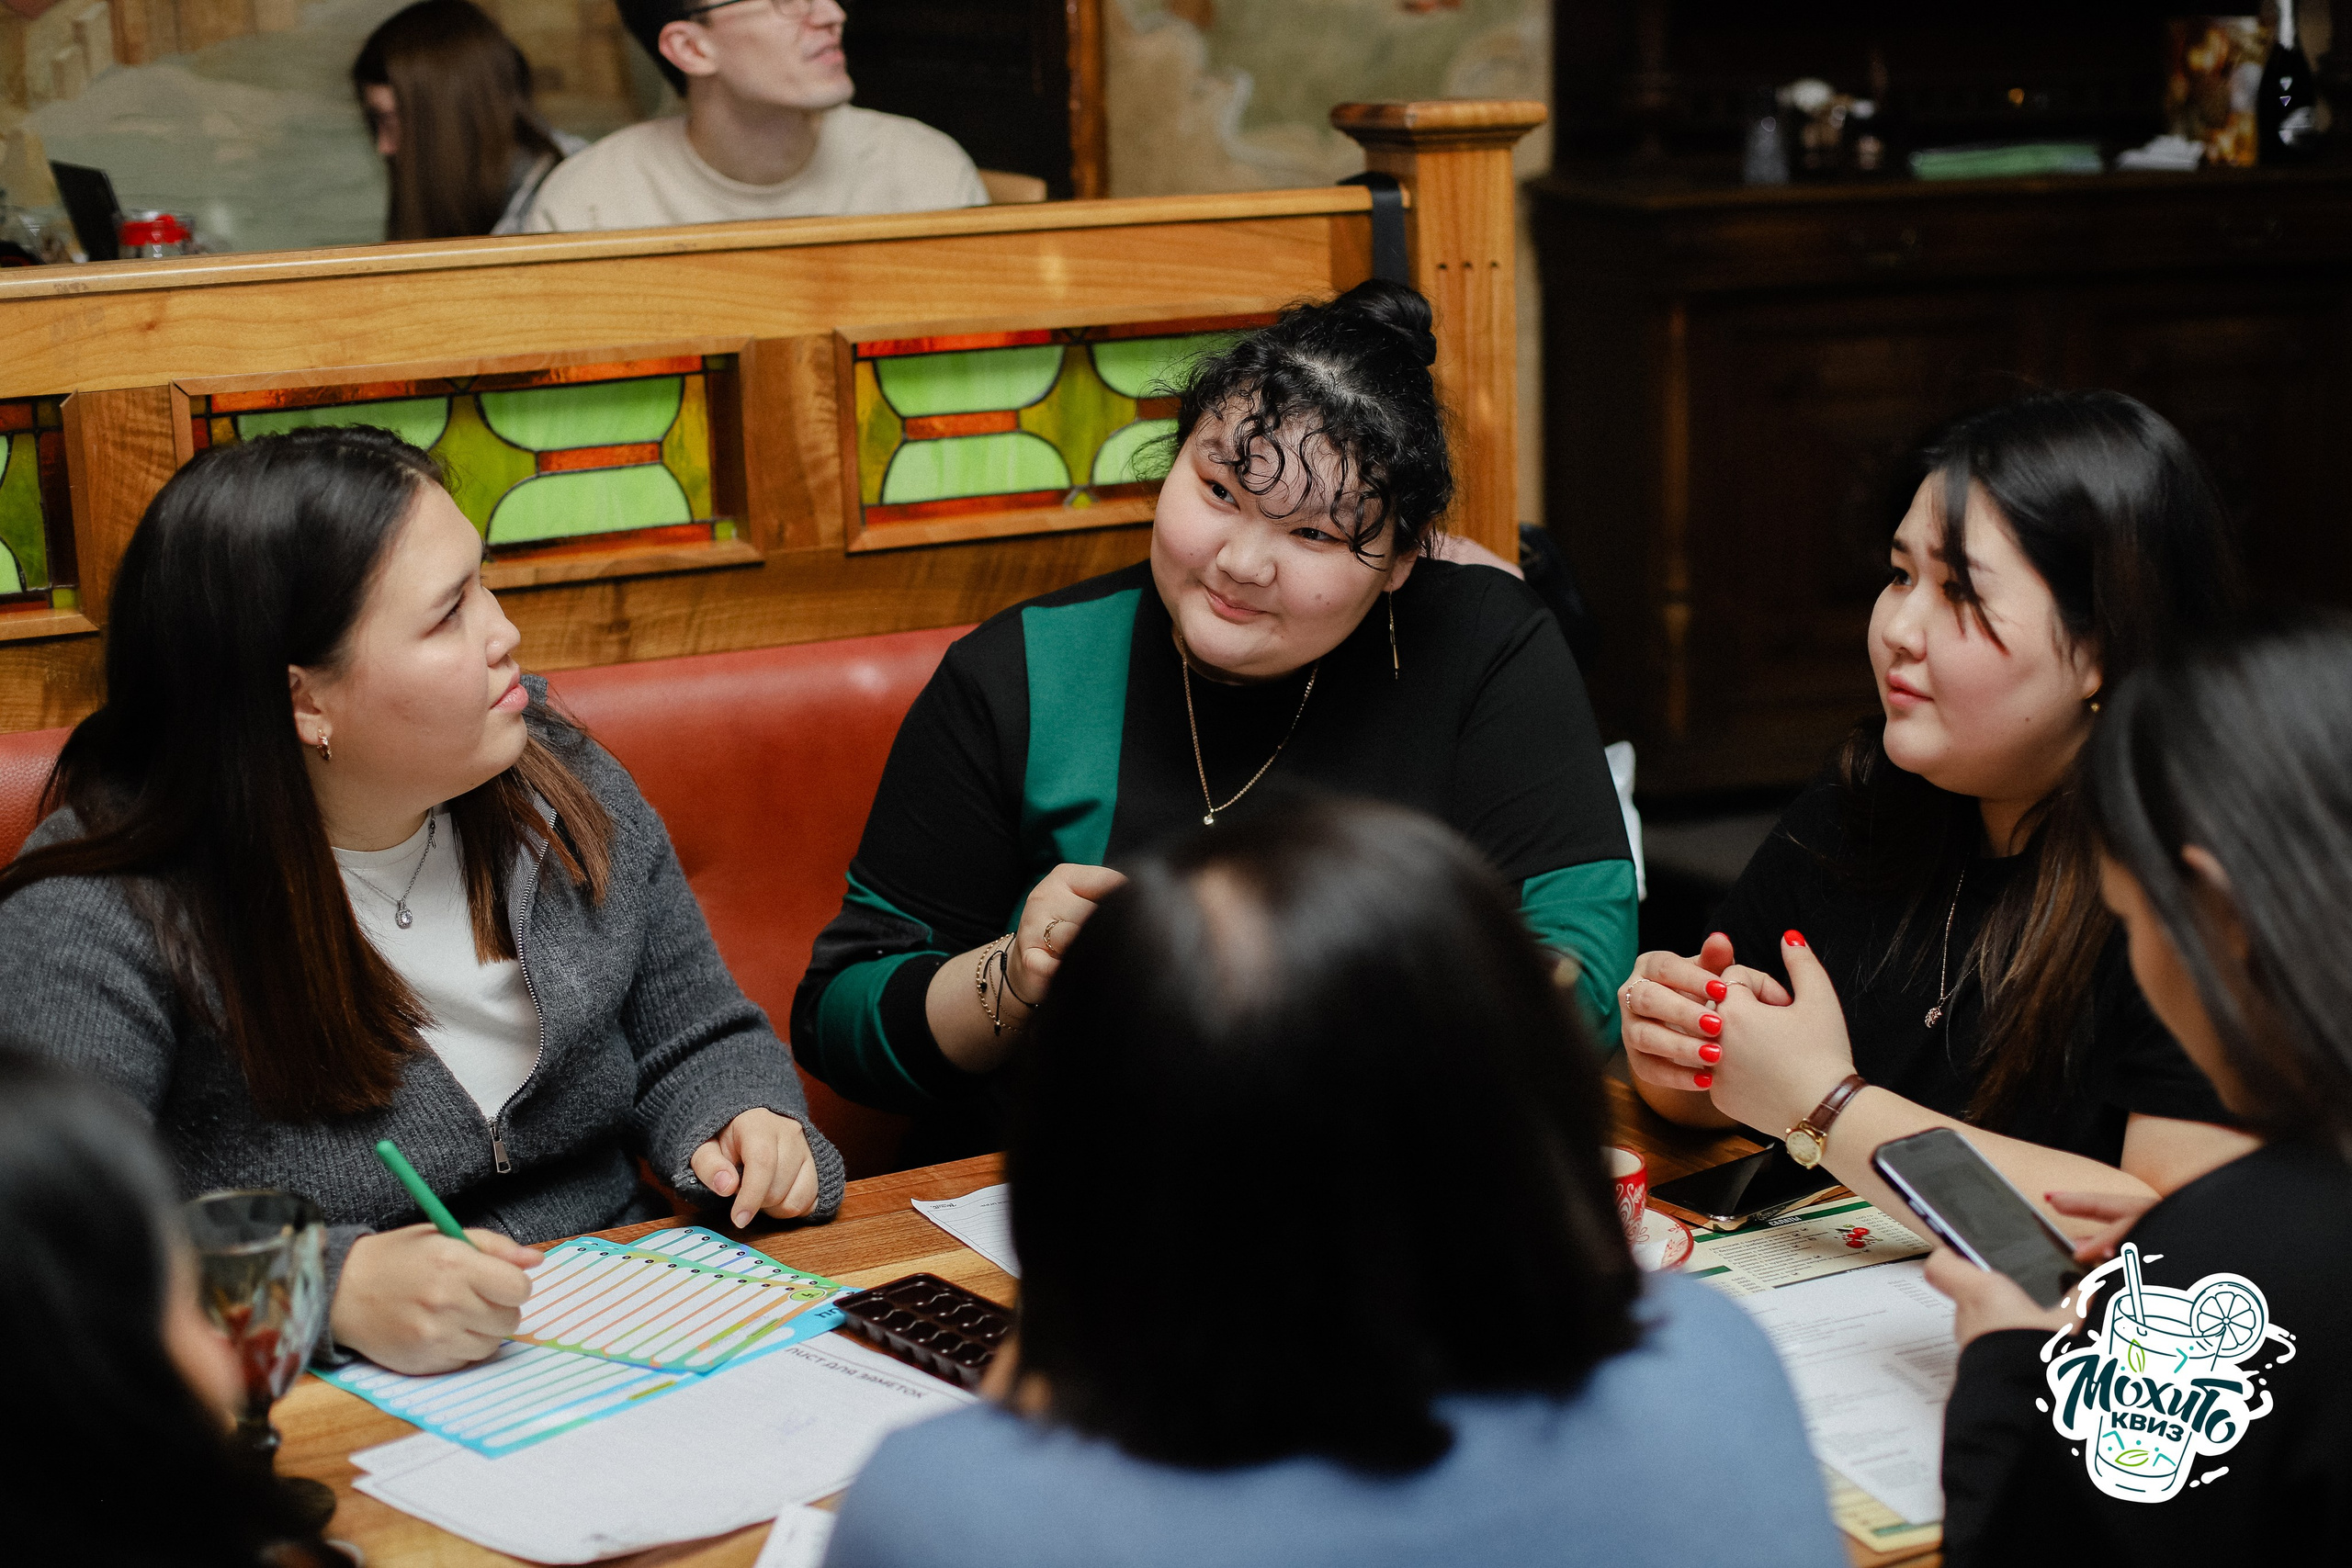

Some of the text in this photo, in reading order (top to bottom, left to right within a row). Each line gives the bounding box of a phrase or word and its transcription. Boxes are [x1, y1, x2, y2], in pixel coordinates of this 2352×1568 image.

[1768, 1215, 1803, 1227] САЛАТЫ
[786, 1348, 925, 1398] ЛИСТ ДЛЯ ЗАМЕТОК
